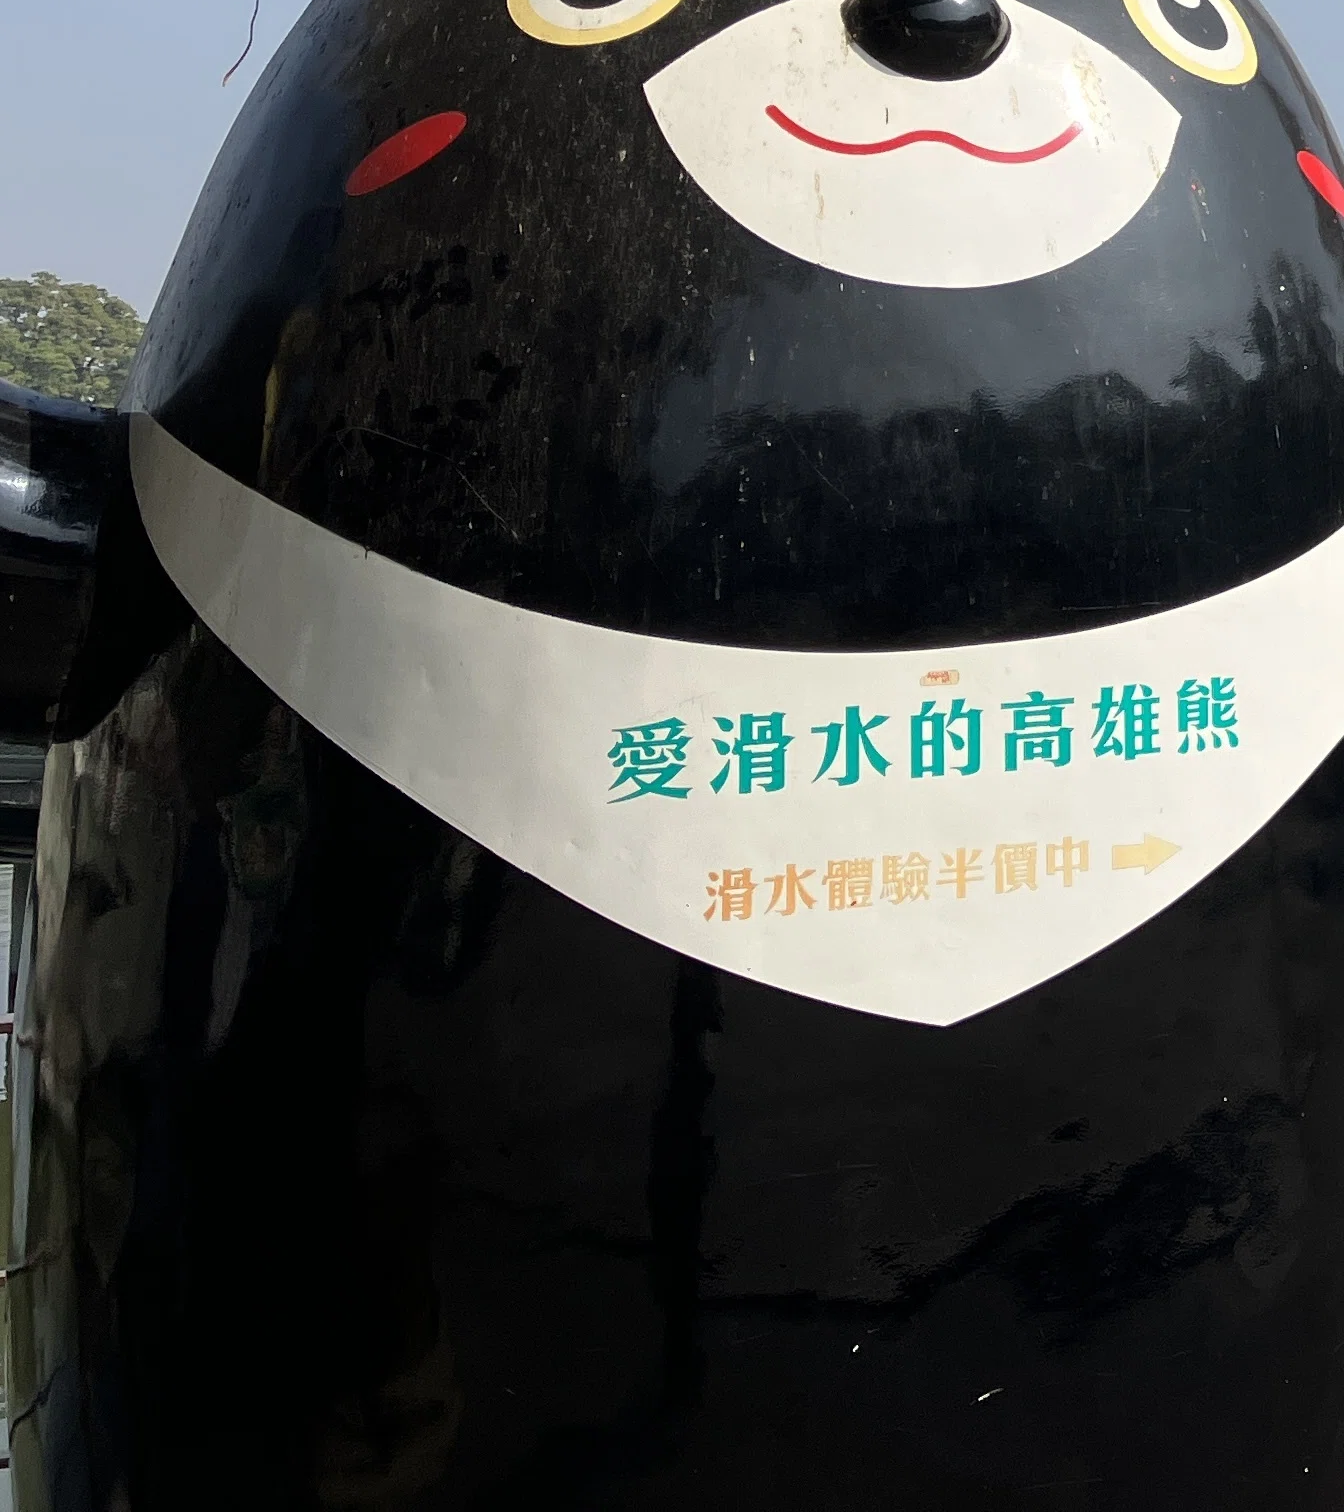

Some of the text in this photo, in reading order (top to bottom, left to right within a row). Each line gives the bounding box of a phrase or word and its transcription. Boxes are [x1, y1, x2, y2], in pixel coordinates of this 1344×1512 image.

[607, 677, 1239, 803] 愛滑水的高雄熊
[703, 836, 1089, 922] 滑水體驗半價中
